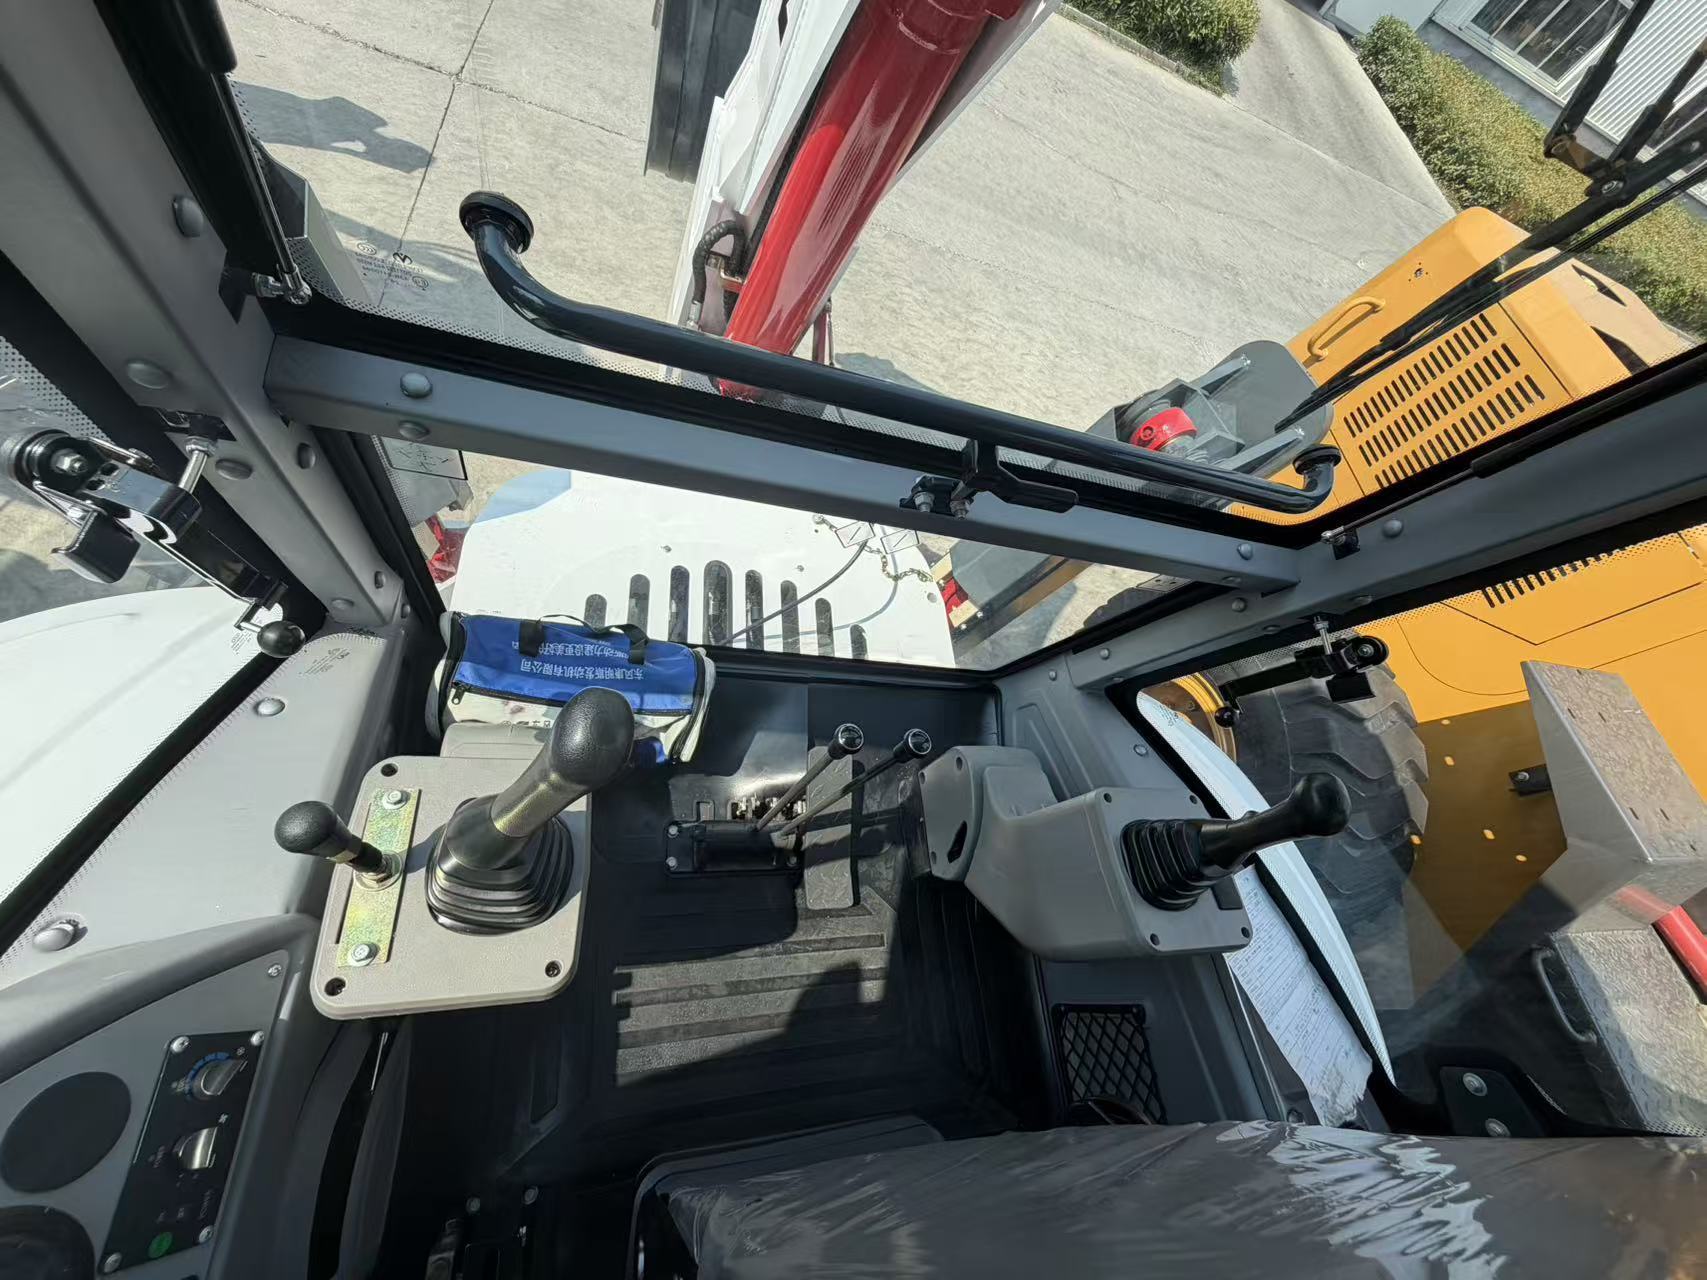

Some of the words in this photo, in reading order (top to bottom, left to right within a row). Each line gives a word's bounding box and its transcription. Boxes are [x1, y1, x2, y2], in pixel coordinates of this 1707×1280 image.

[520, 658, 643, 680] 东风康明斯发动机有限公司
